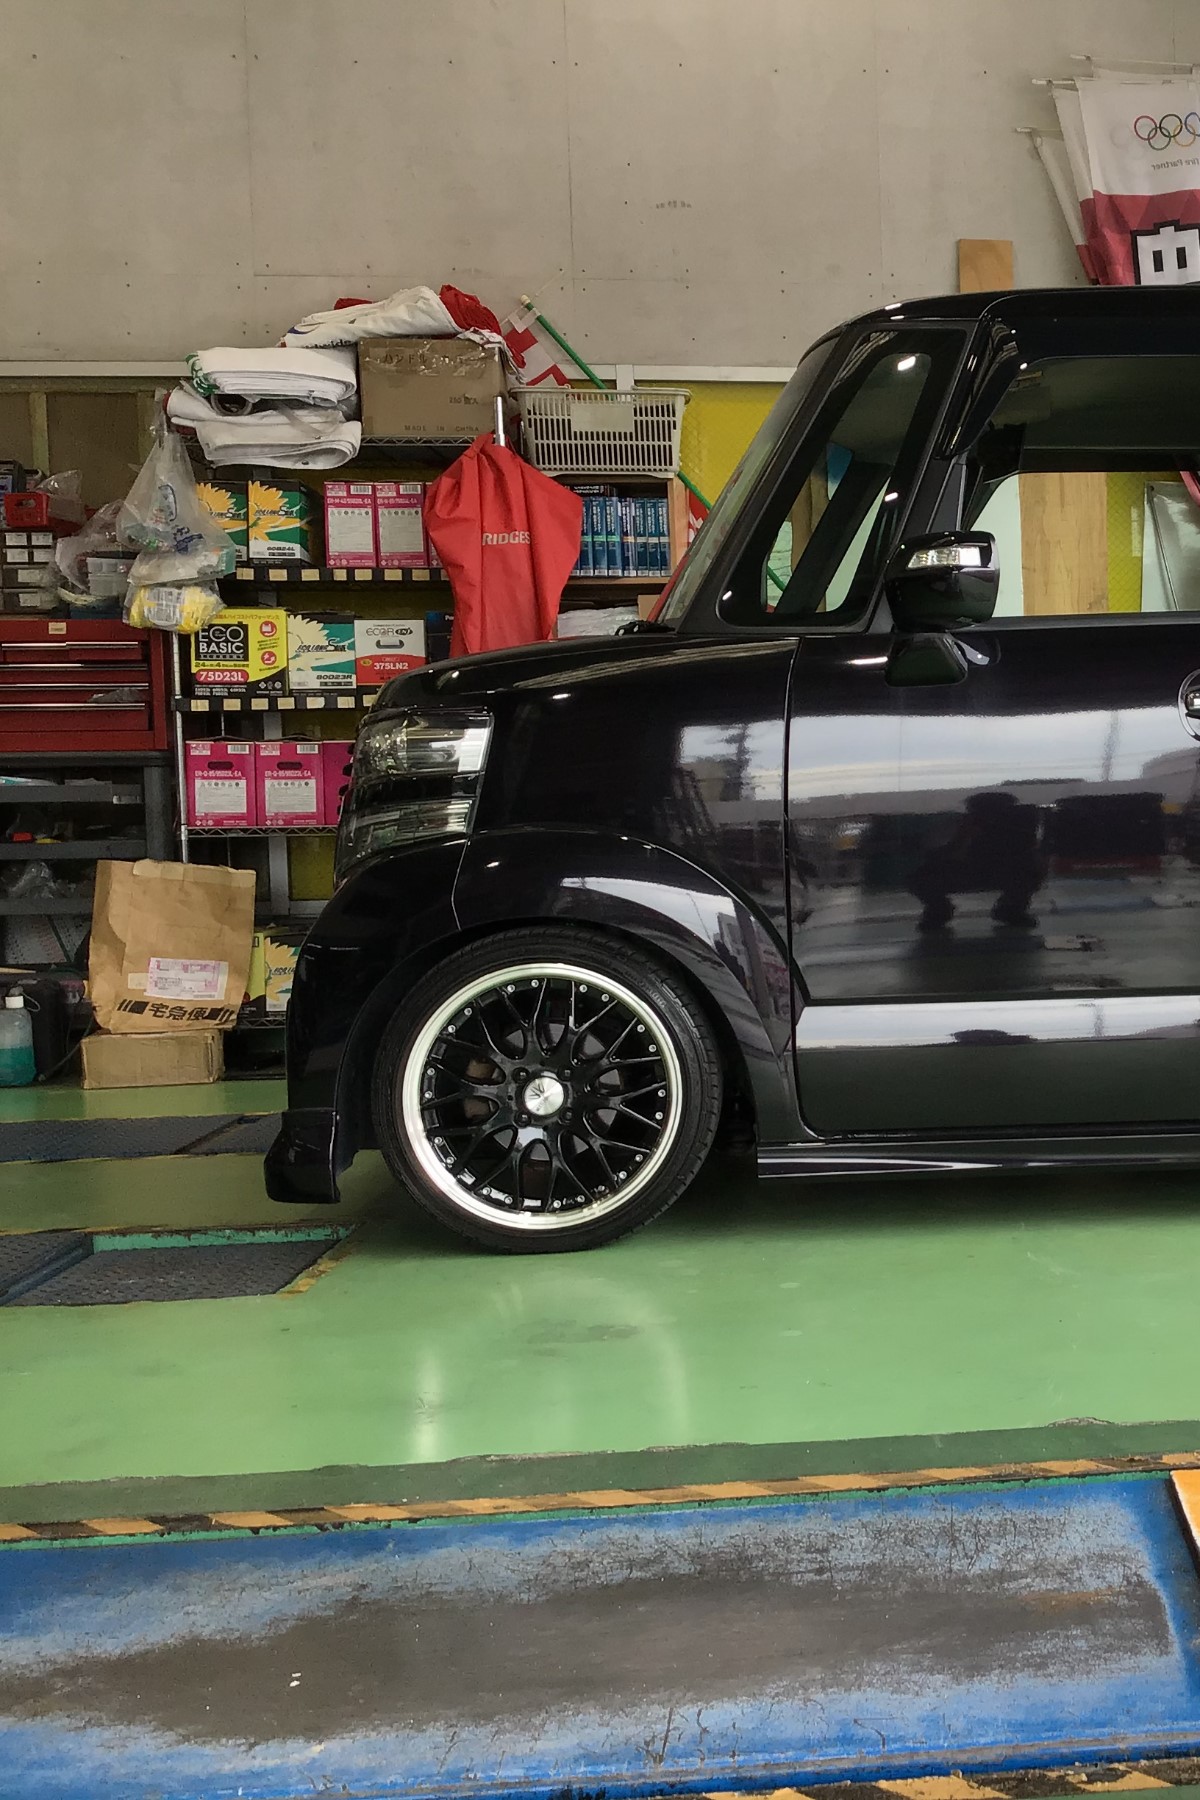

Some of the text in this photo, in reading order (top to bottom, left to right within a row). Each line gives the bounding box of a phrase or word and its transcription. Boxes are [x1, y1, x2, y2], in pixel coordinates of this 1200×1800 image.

[482, 530, 530, 546] RIDGES
[199, 626, 244, 642] ECO
[199, 642, 244, 653] BASIC
[374, 662, 409, 670] 375LN2
[200, 671, 244, 681] 75D23L
[149, 1003, 207, 1021] 宅急便
